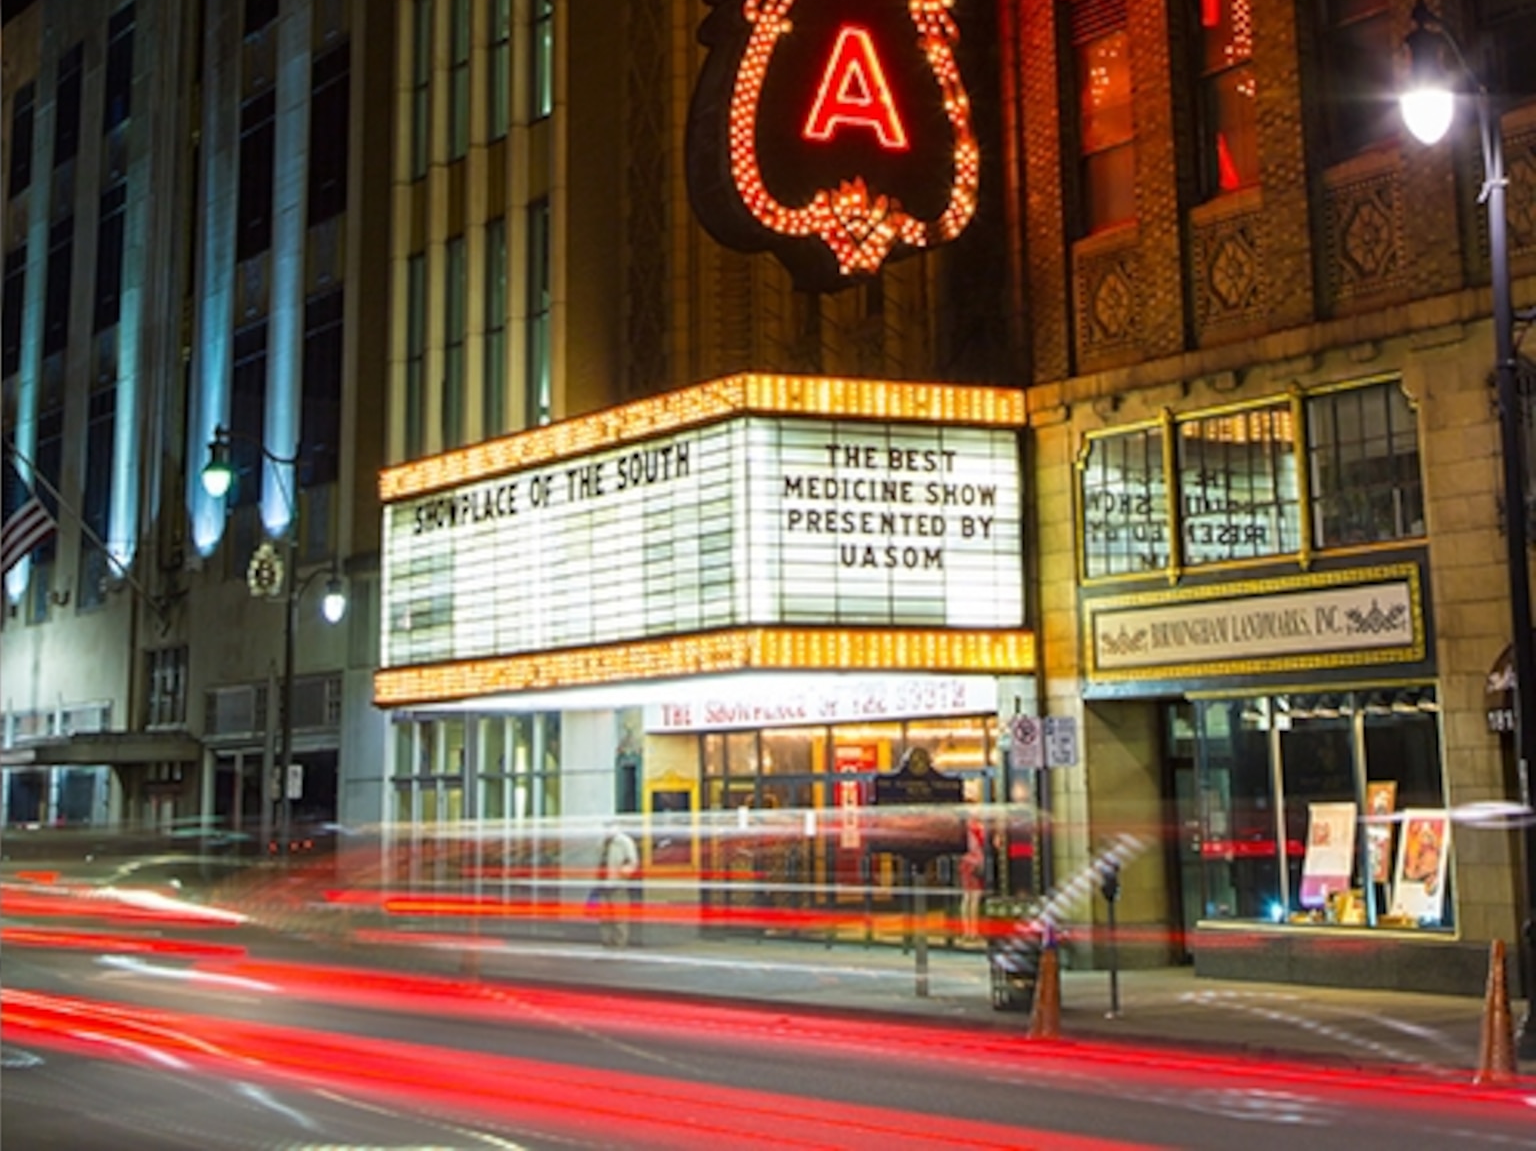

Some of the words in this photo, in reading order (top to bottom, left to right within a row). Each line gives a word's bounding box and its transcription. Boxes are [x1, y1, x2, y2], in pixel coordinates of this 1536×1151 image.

[825, 444, 878, 469] THE
[887, 446, 956, 472] BEST
[414, 484, 517, 535] SHOWPLACE
[530, 475, 553, 508] OF
[566, 463, 604, 502] THE
[617, 441, 691, 491] SOUTH
[784, 475, 913, 503] MEDICINE
[925, 481, 997, 507] SHOW
[787, 508, 946, 537] PRESENTED
[960, 514, 995, 539] BY
[840, 543, 945, 570] UASOM
